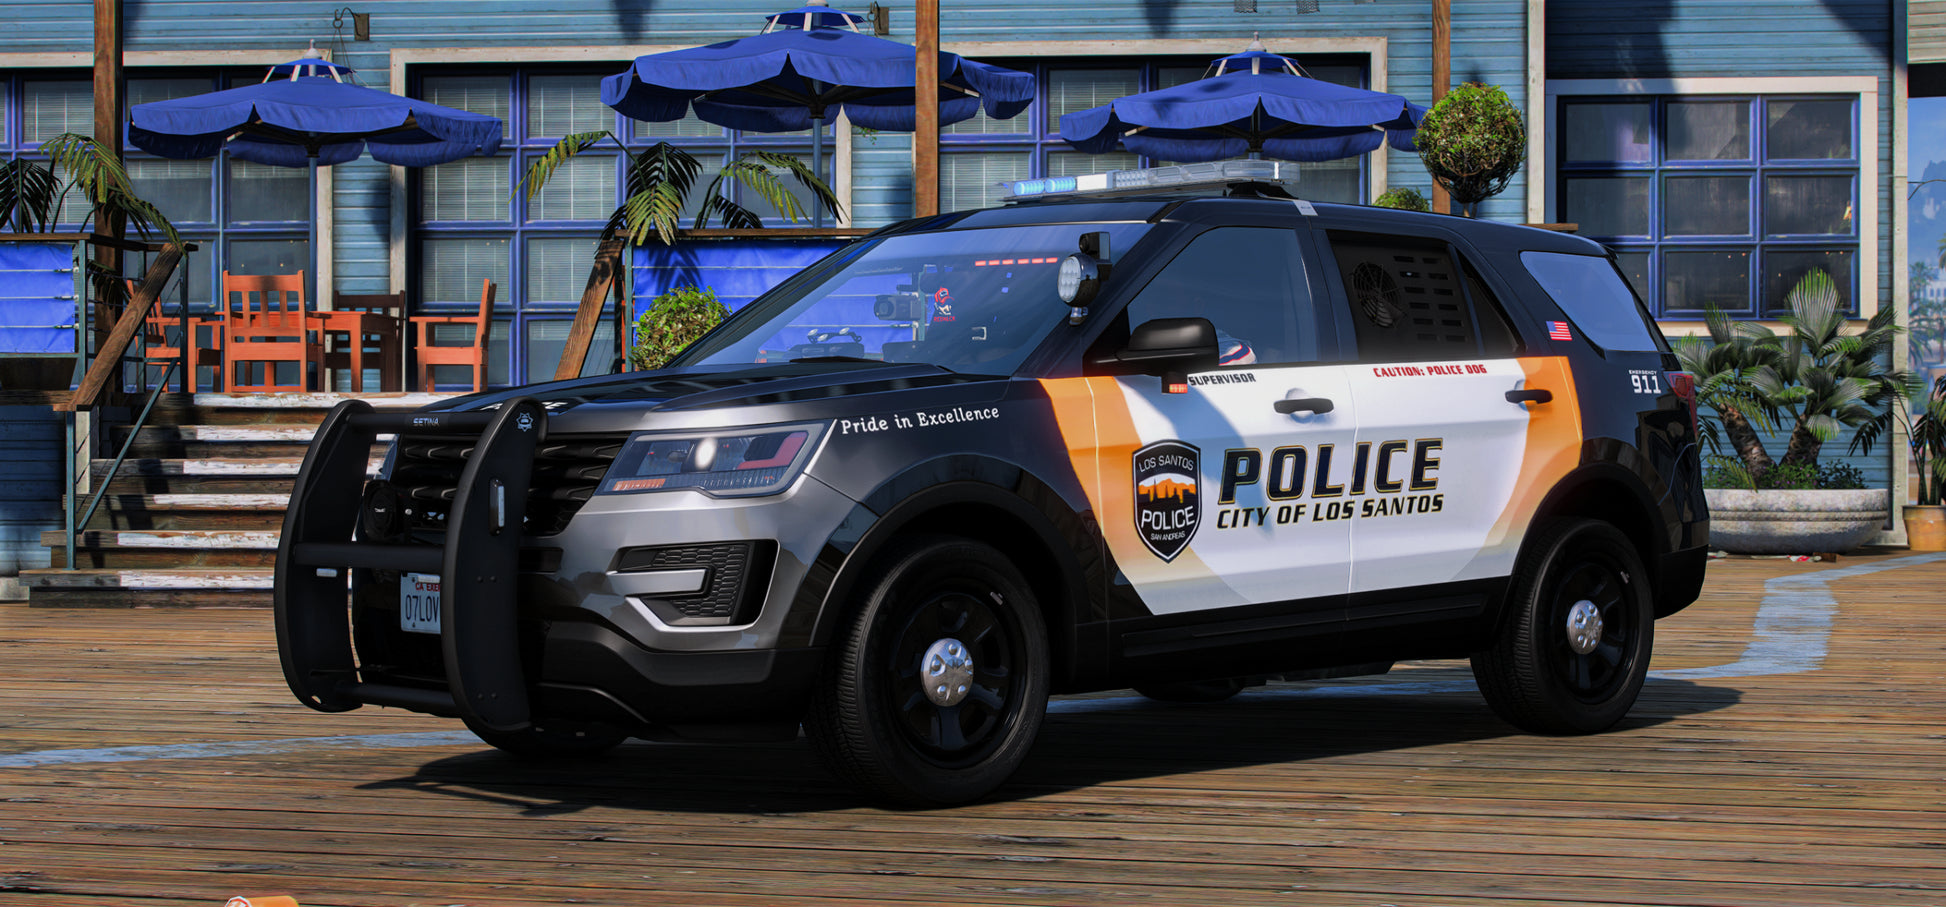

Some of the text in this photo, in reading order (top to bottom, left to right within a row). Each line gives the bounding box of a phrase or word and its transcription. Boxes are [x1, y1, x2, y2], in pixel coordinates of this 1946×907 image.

[1188, 372, 1257, 386] SUPERVISOR
[1373, 364, 1487, 378] CAUTION: POLICE DOG
[1631, 374, 1661, 394] 911
[841, 407, 1000, 434] Pride in Excellence
[1138, 454, 1194, 473] LOS SANTOS
[1218, 438, 1443, 505] POLICE
[1141, 505, 1195, 530] POLICE
[1216, 494, 1444, 529] CITY OF LOS SANTOS
[1150, 532, 1162, 541] SAN
[415, 582, 425, 592] CA
